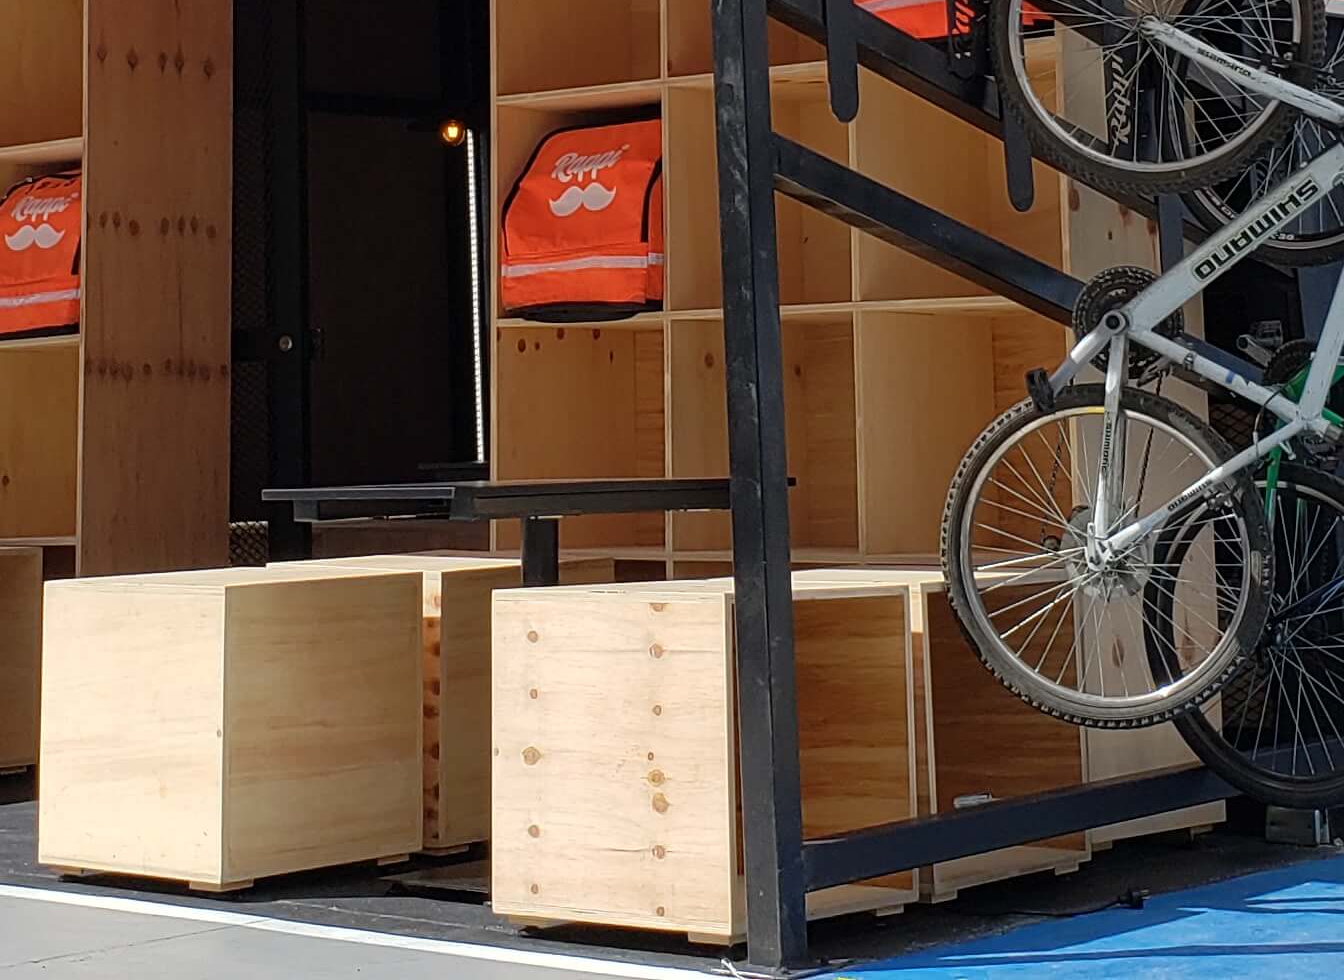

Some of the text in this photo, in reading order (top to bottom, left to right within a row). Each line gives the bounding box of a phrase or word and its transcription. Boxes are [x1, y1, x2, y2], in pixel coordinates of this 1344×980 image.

[551, 143, 630, 183] Rappi
[11, 191, 80, 222] Rappi
[1192, 178, 1320, 282] SHIMANO
